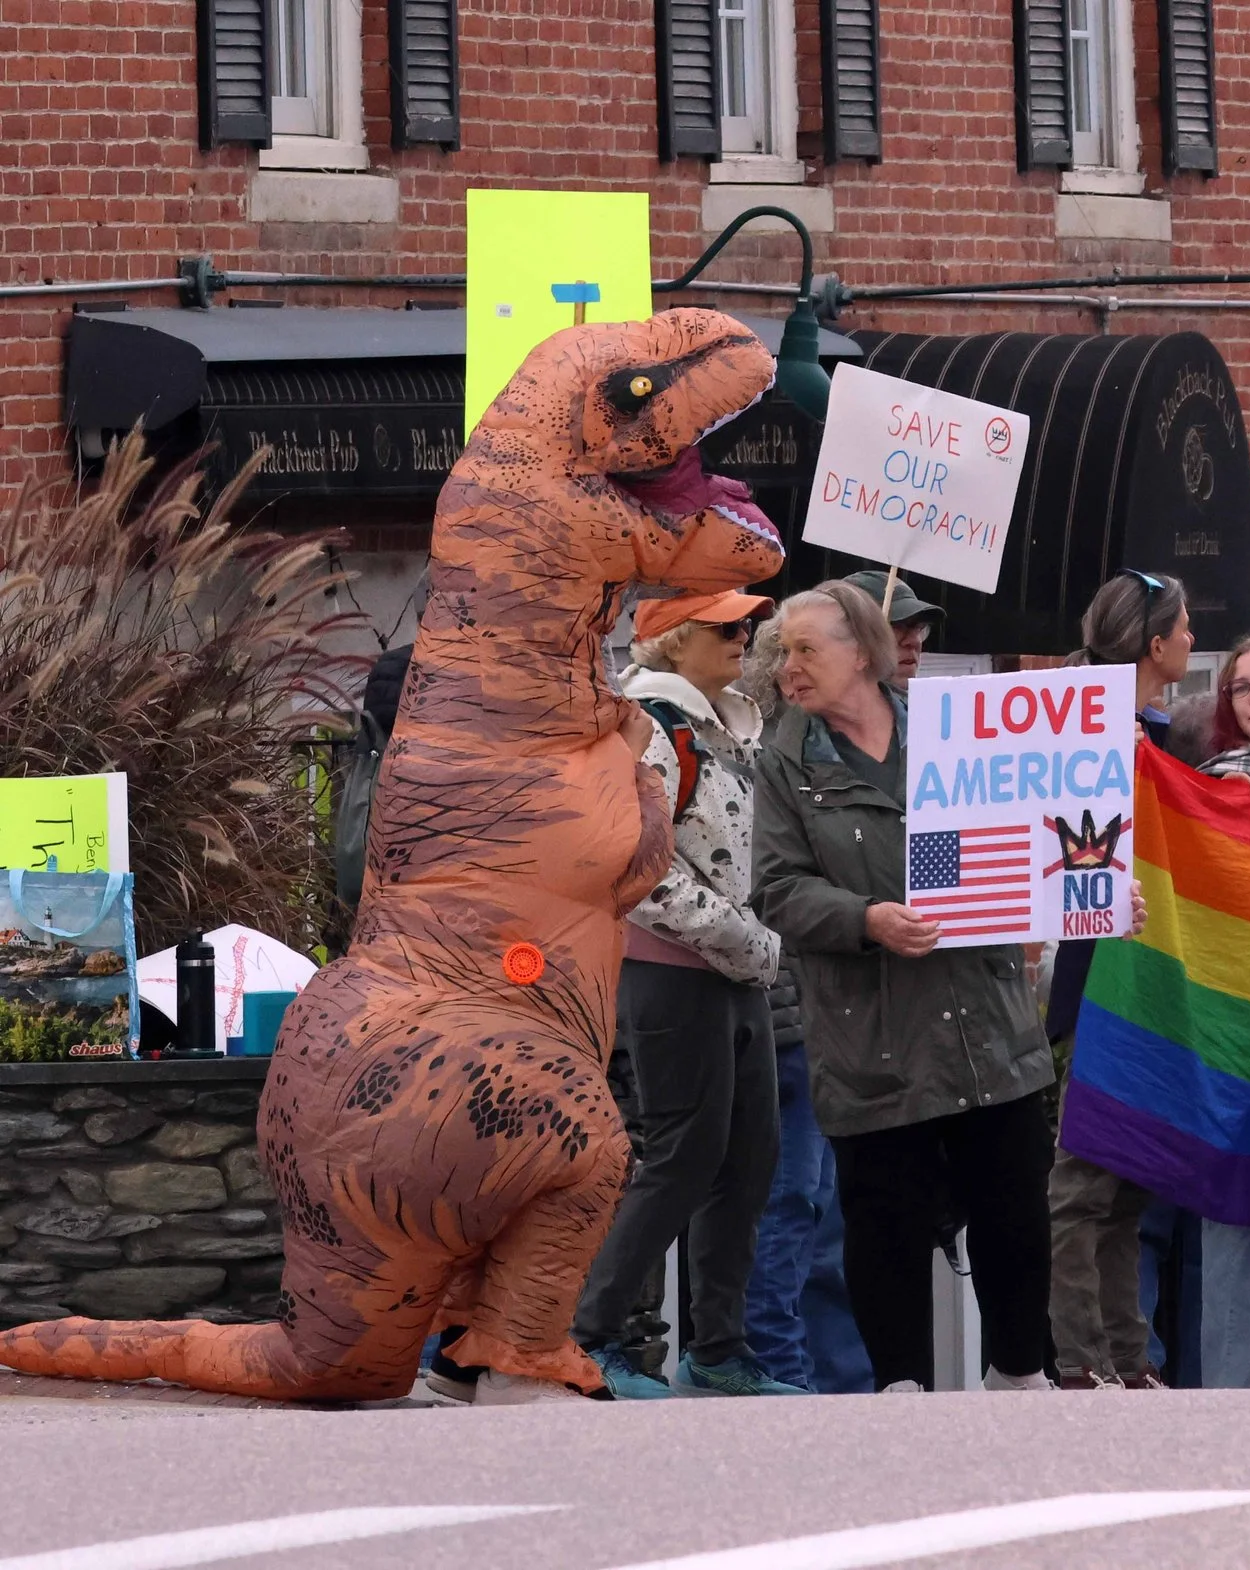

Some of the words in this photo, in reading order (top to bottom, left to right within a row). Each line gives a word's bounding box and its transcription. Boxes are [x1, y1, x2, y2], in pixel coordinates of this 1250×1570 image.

[329, 429, 360, 473] Pub
[887, 404, 962, 457] SAVE
[884, 450, 949, 496] OUR
[823, 471, 998, 554] DEMOCRACY!!
[940, 692, 952, 741] I
[973, 685, 1106, 739] LOVE
[912, 748, 1131, 811] AMERICA
[1062, 871, 1113, 912] NO
[1062, 909, 1113, 937] KINGS
